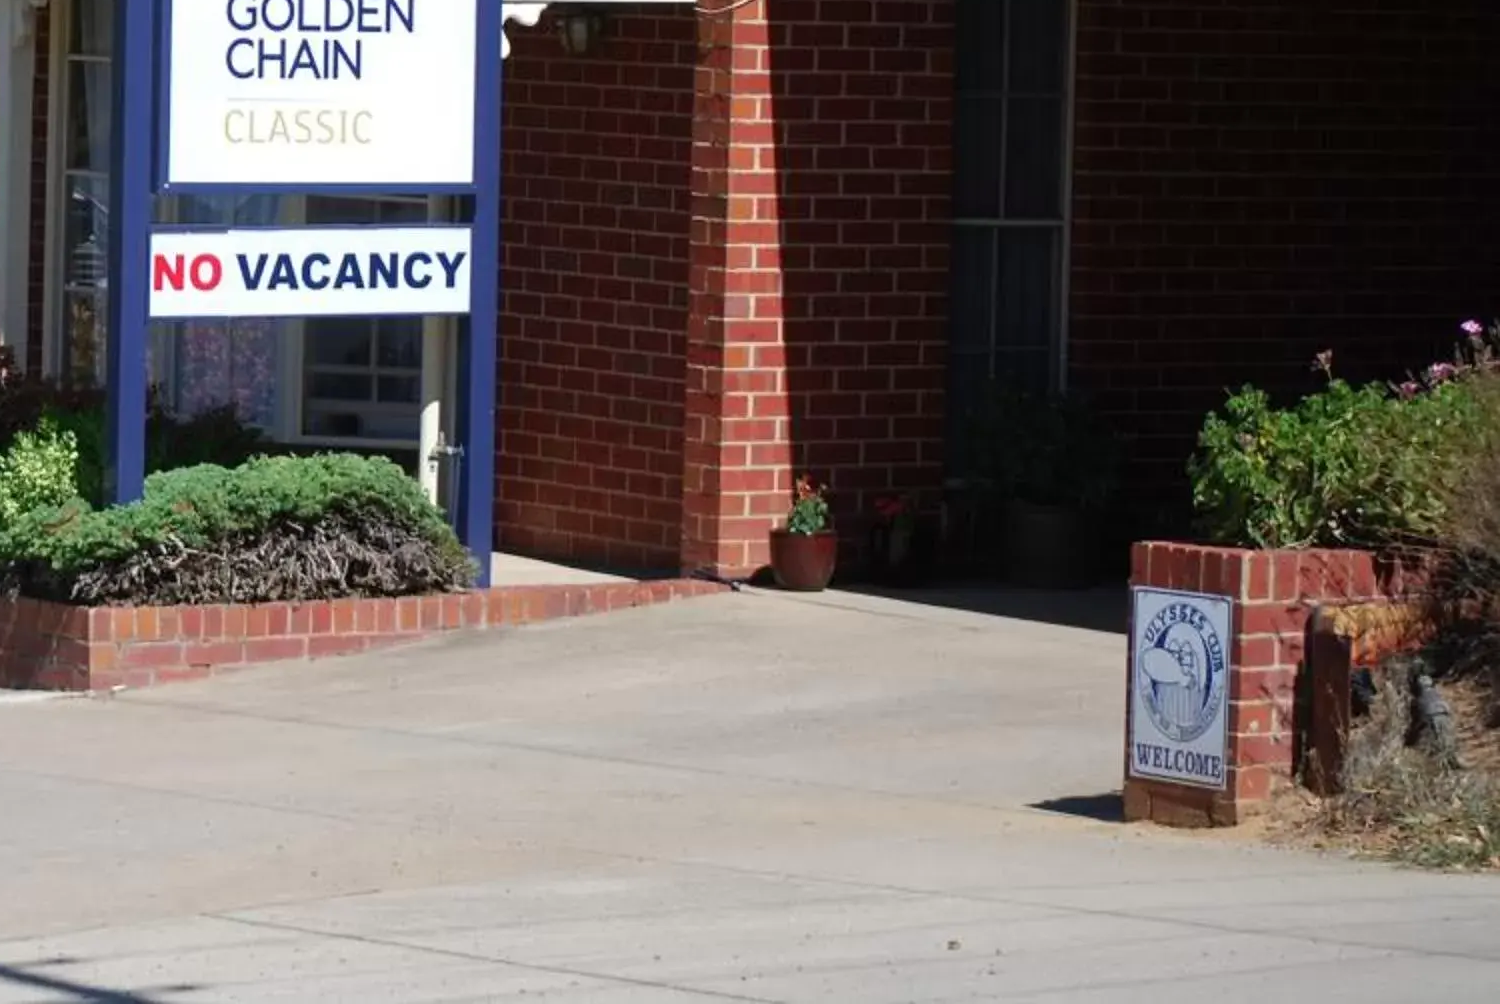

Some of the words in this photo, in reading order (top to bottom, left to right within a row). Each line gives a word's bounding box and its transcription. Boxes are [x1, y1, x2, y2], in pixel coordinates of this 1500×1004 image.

[225, 38, 362, 80] CHAIN
[224, 108, 373, 145] CLASSIC
[153, 253, 223, 291] NO
[236, 252, 466, 290] VACANCY
[1145, 603, 1206, 642] ULYSSES
[1137, 743, 1221, 779] WELCOME
